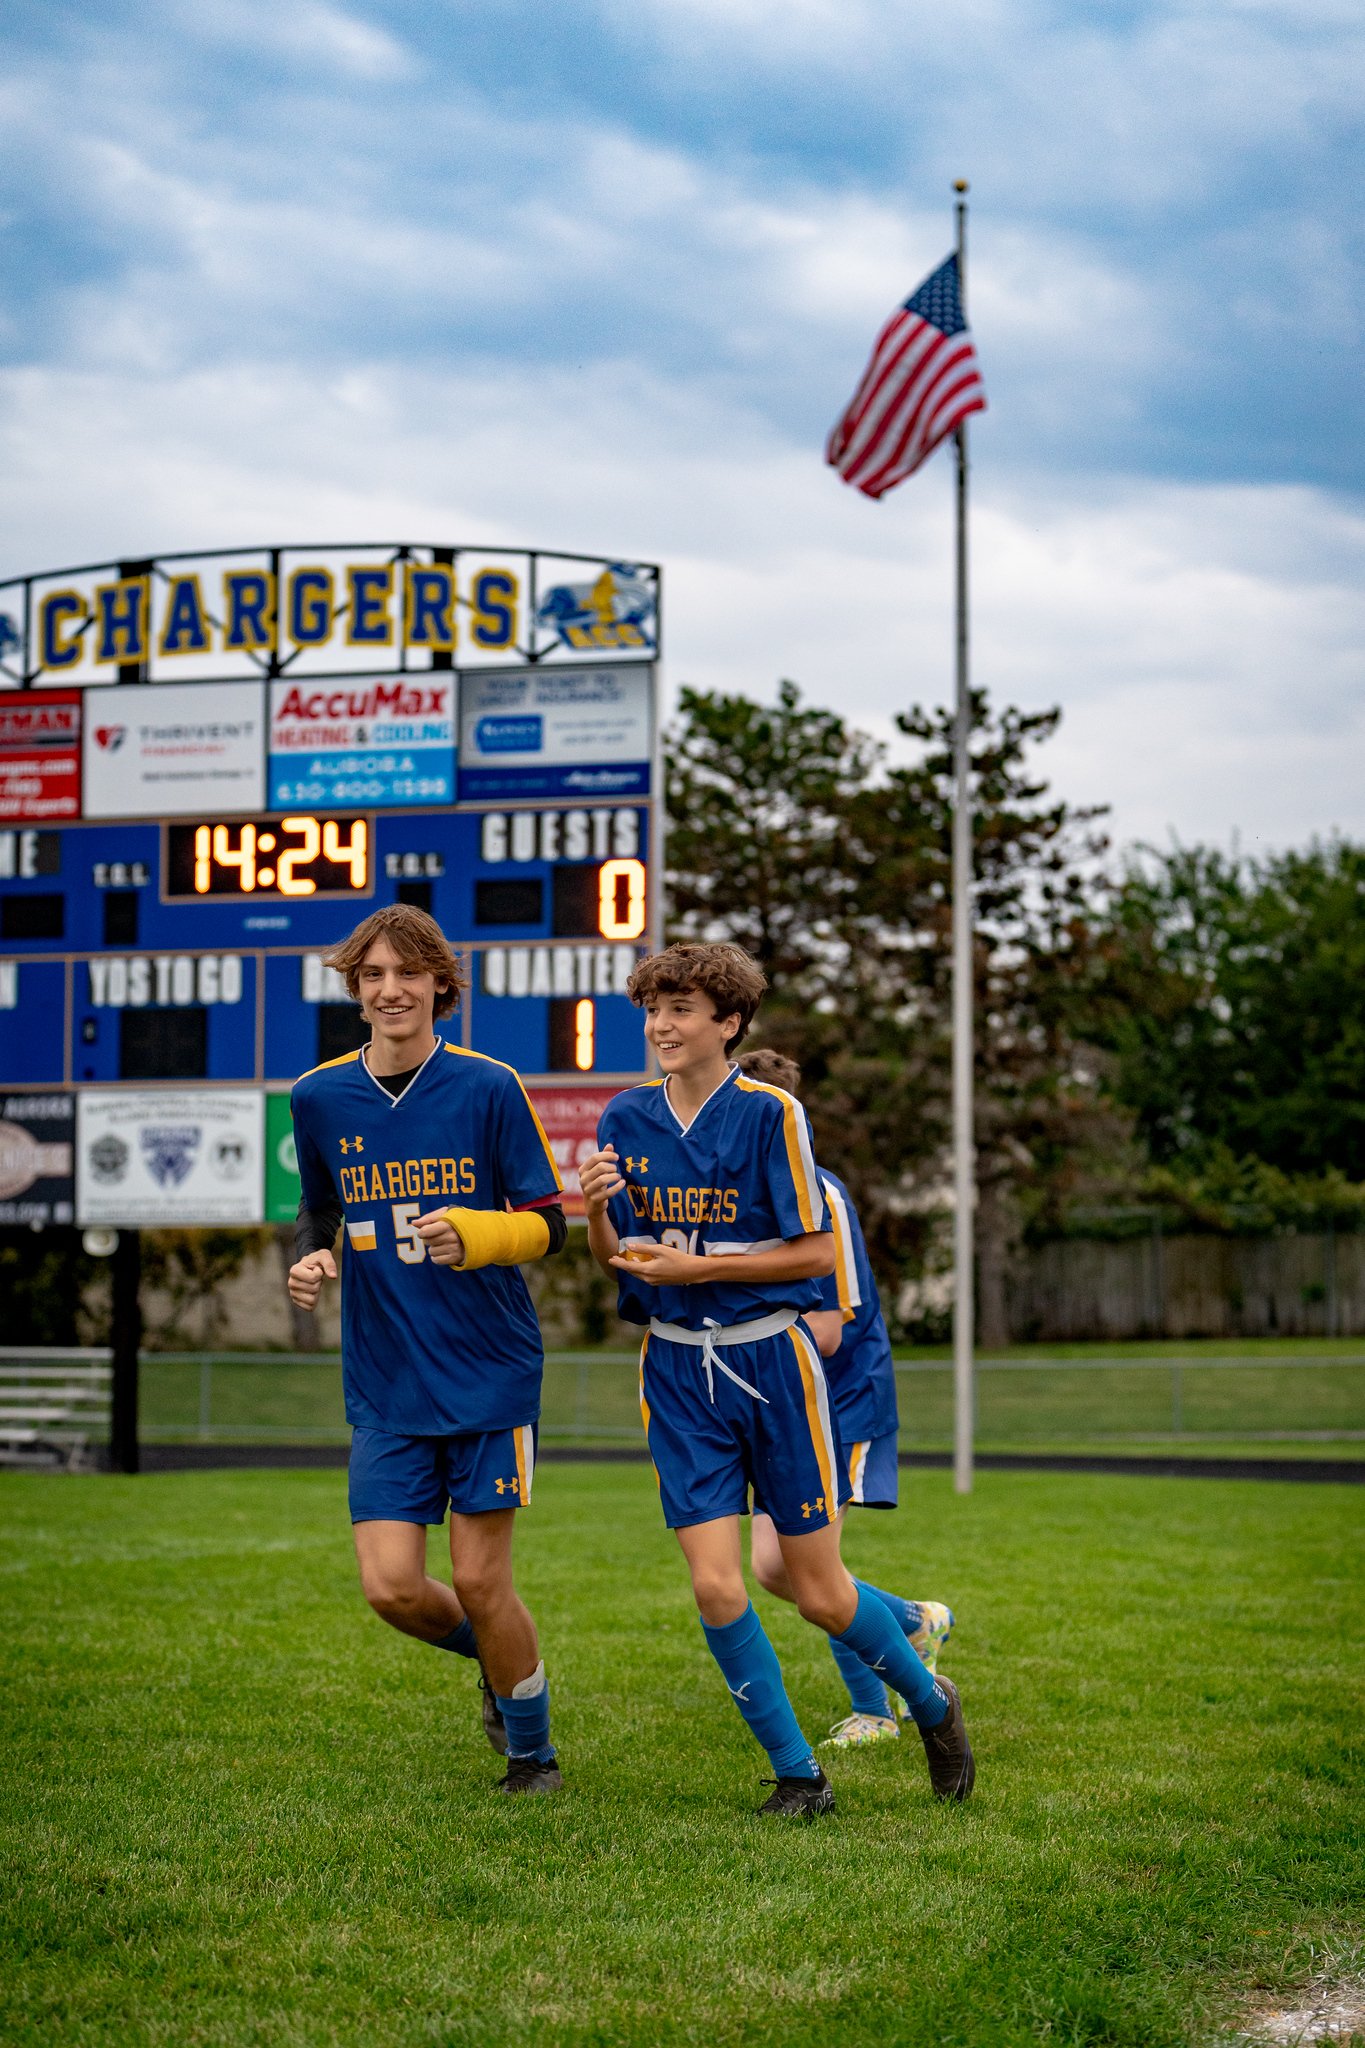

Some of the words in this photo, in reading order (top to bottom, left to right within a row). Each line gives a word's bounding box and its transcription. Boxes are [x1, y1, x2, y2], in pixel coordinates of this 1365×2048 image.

[39, 563, 519, 672] CHARGERS
[277, 682, 446, 721] AccuMax
[139, 722, 254, 741] THRIVENT
[275, 726, 350, 747] HEATING
[356, 725, 367, 745] &
[374, 721, 452, 744] COOLING
[309, 756, 415, 776] AURORA
[195, 817, 367, 896] 14:24
[481, 808, 640, 863] GUESTS
[599, 858, 646, 940] 0
[484, 946, 636, 998] QUARTER
[575, 998, 594, 1071] 1
[340, 1157, 476, 1204] CHARGERS
[391, 1202, 427, 1265] 5
